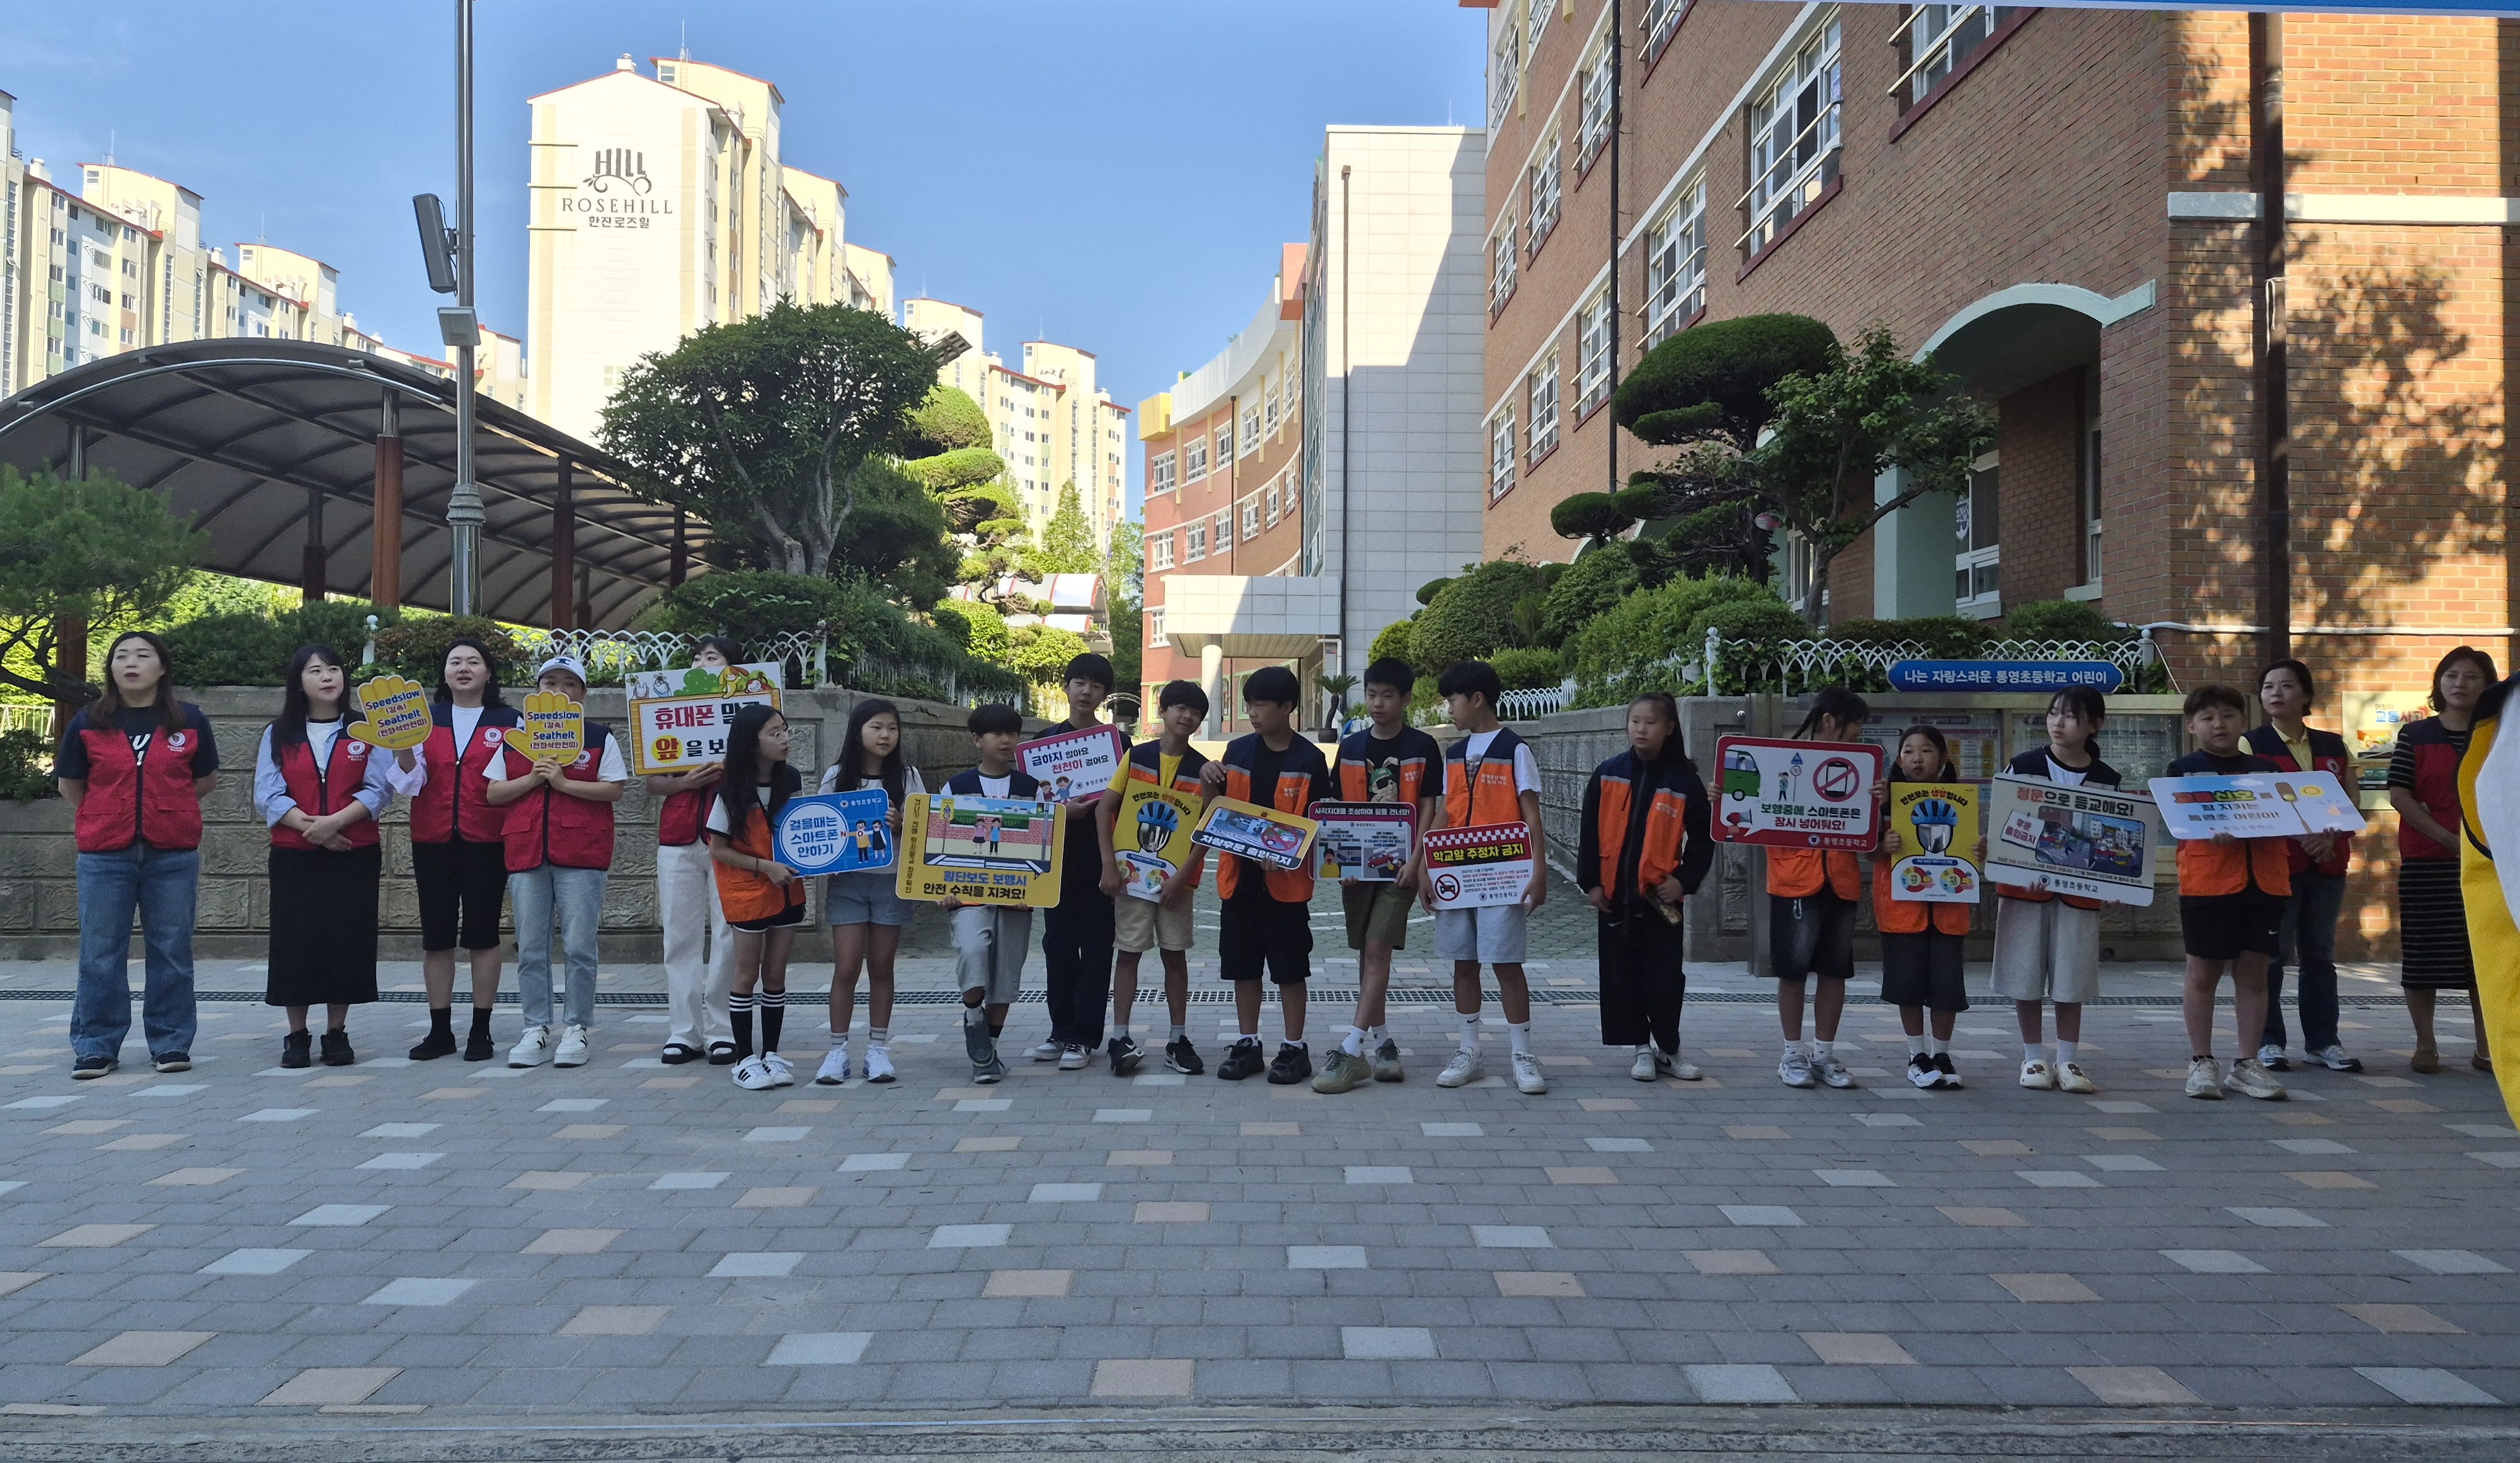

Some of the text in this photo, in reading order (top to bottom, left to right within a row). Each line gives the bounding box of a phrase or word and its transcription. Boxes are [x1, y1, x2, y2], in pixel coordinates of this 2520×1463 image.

[595, 148, 646, 177] HILL
[562, 197, 673, 214] ROSEHILL
[588, 215, 650, 229] 한진로즈힐
[1904, 670, 2107, 685] 나는 자랑스러운 통영초등학교 어린이
[365, 690, 420, 710] Speedslow
[386, 703, 406, 714] (감속)
[527, 711, 580, 721] Speedslow
[654, 704, 715, 730] 휴대폰
[1031, 750, 1063, 767] 급하지
[1051, 755, 1109, 774] 천천히 걸어요
[1132, 791, 1159, 802] 안전모는
[1900, 789, 1930, 806] 안전모는
[1761, 803, 1861, 820] 보행중에 스마트폰은
[2075, 795, 2134, 817] 등교해요!
[789, 816, 837, 831] 걸을때는
[1775, 816, 1796, 828] 잠시
[791, 829, 839, 845] 스마트폰
[1200, 834, 1246, 852] 차량후문
[798, 843, 834, 858] 안하기
[1433, 842, 1525, 863] 학교앞 주정차 금지
[943, 871, 1027, 886] 횡단보도 보행시
[924, 883, 1026, 900] 안전 수칙을 지켜요!
